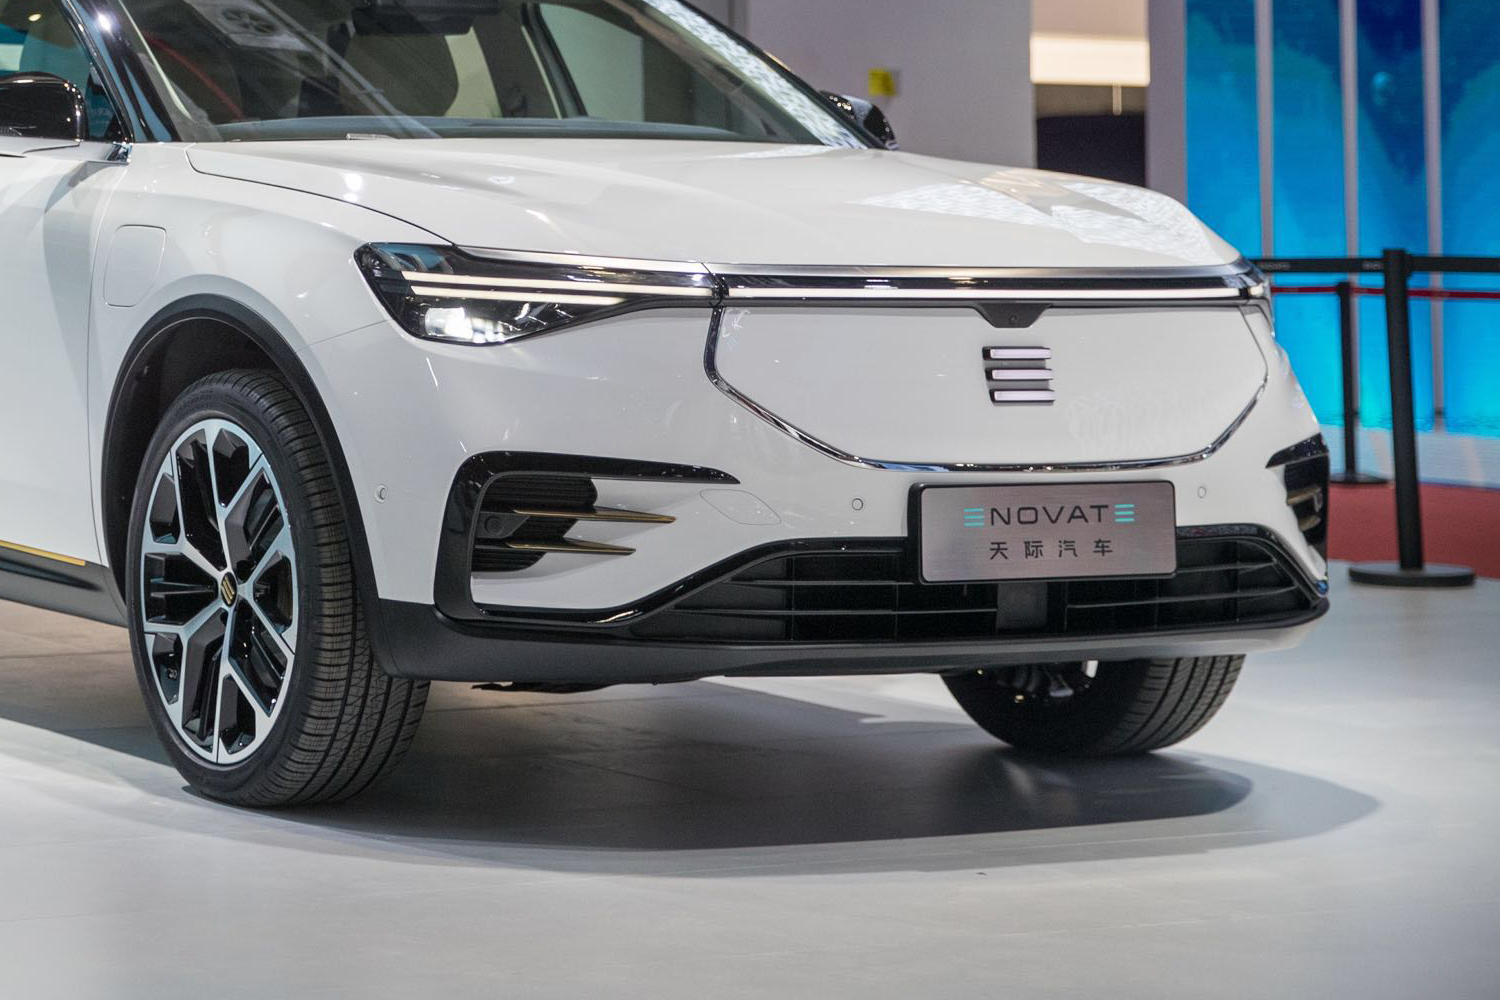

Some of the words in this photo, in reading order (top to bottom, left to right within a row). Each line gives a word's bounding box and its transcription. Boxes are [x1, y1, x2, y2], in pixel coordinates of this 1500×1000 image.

[963, 503, 1135, 527] ENOVATE
[989, 538, 1114, 560] 天际汽车
